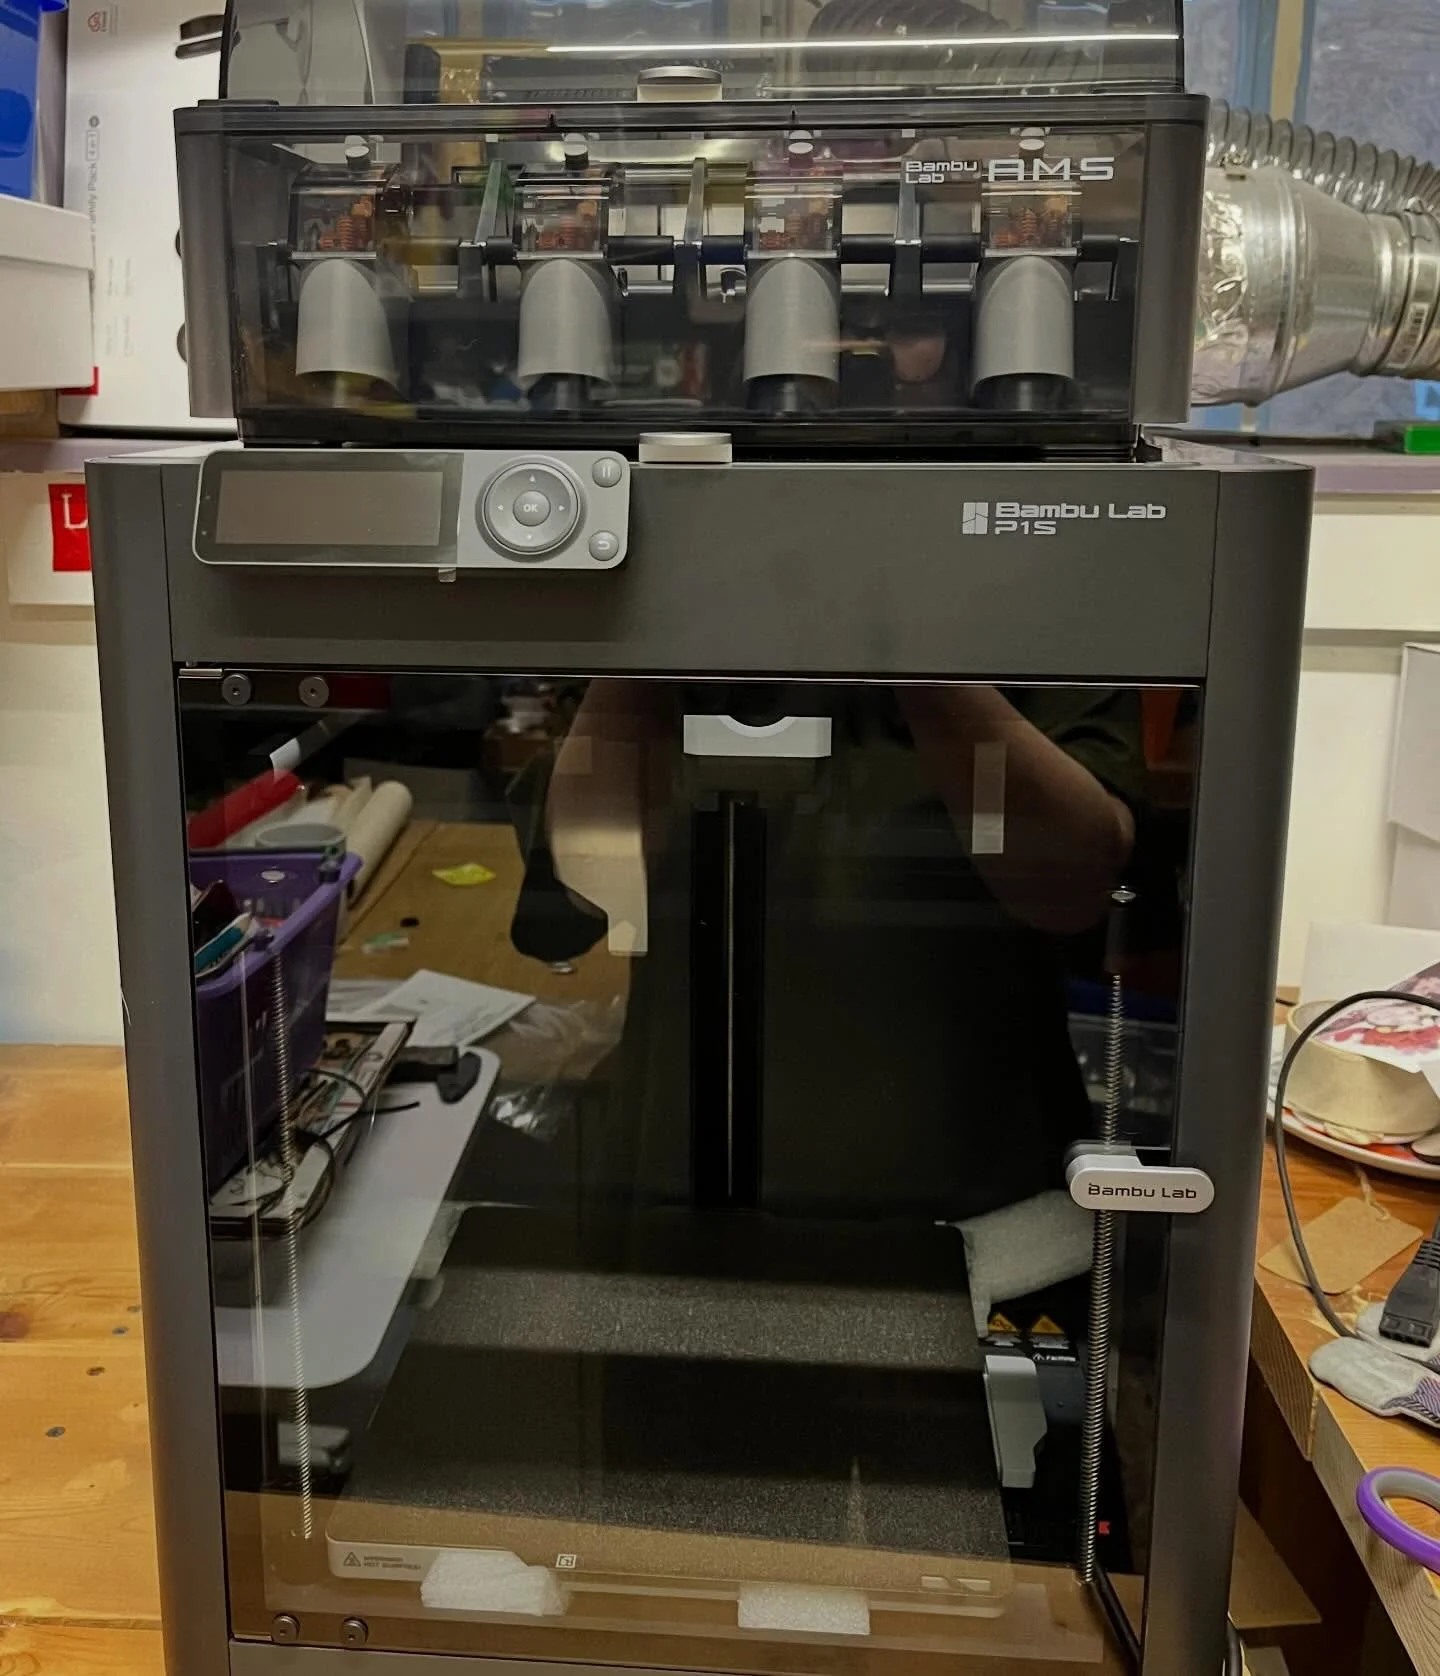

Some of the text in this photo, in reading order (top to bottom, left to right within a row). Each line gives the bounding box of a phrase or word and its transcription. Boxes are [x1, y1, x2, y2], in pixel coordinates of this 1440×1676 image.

[905, 160, 977, 172] Bambu
[988, 156, 1115, 182] AMS
[905, 173, 945, 184] Lab
[523, 503, 538, 513] OK
[995, 502, 1167, 519] Bambu Lab
[994, 520, 1057, 535] P1S
[1087, 1183, 1197, 1199] Bambu Lab
